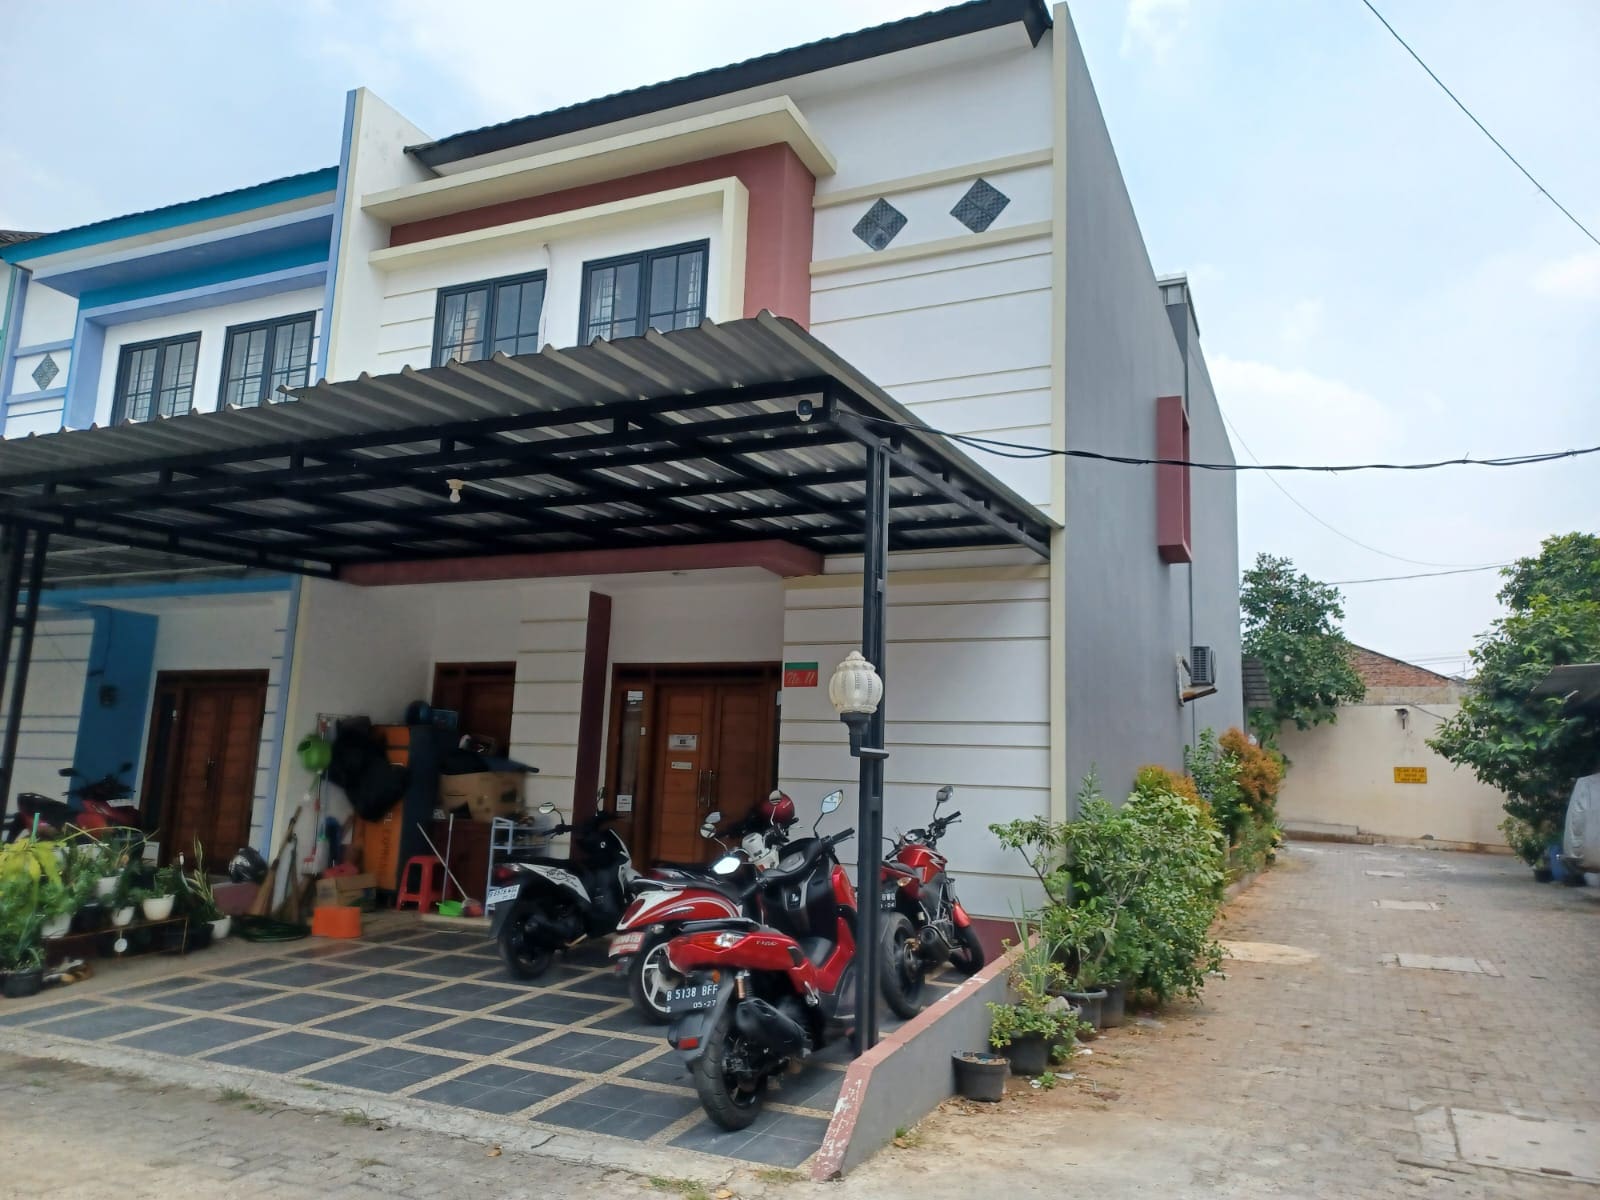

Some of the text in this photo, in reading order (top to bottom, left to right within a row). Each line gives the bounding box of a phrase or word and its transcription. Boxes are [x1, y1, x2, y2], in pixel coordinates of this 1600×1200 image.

[666, 984, 719, 1001] B 5138 BFF
